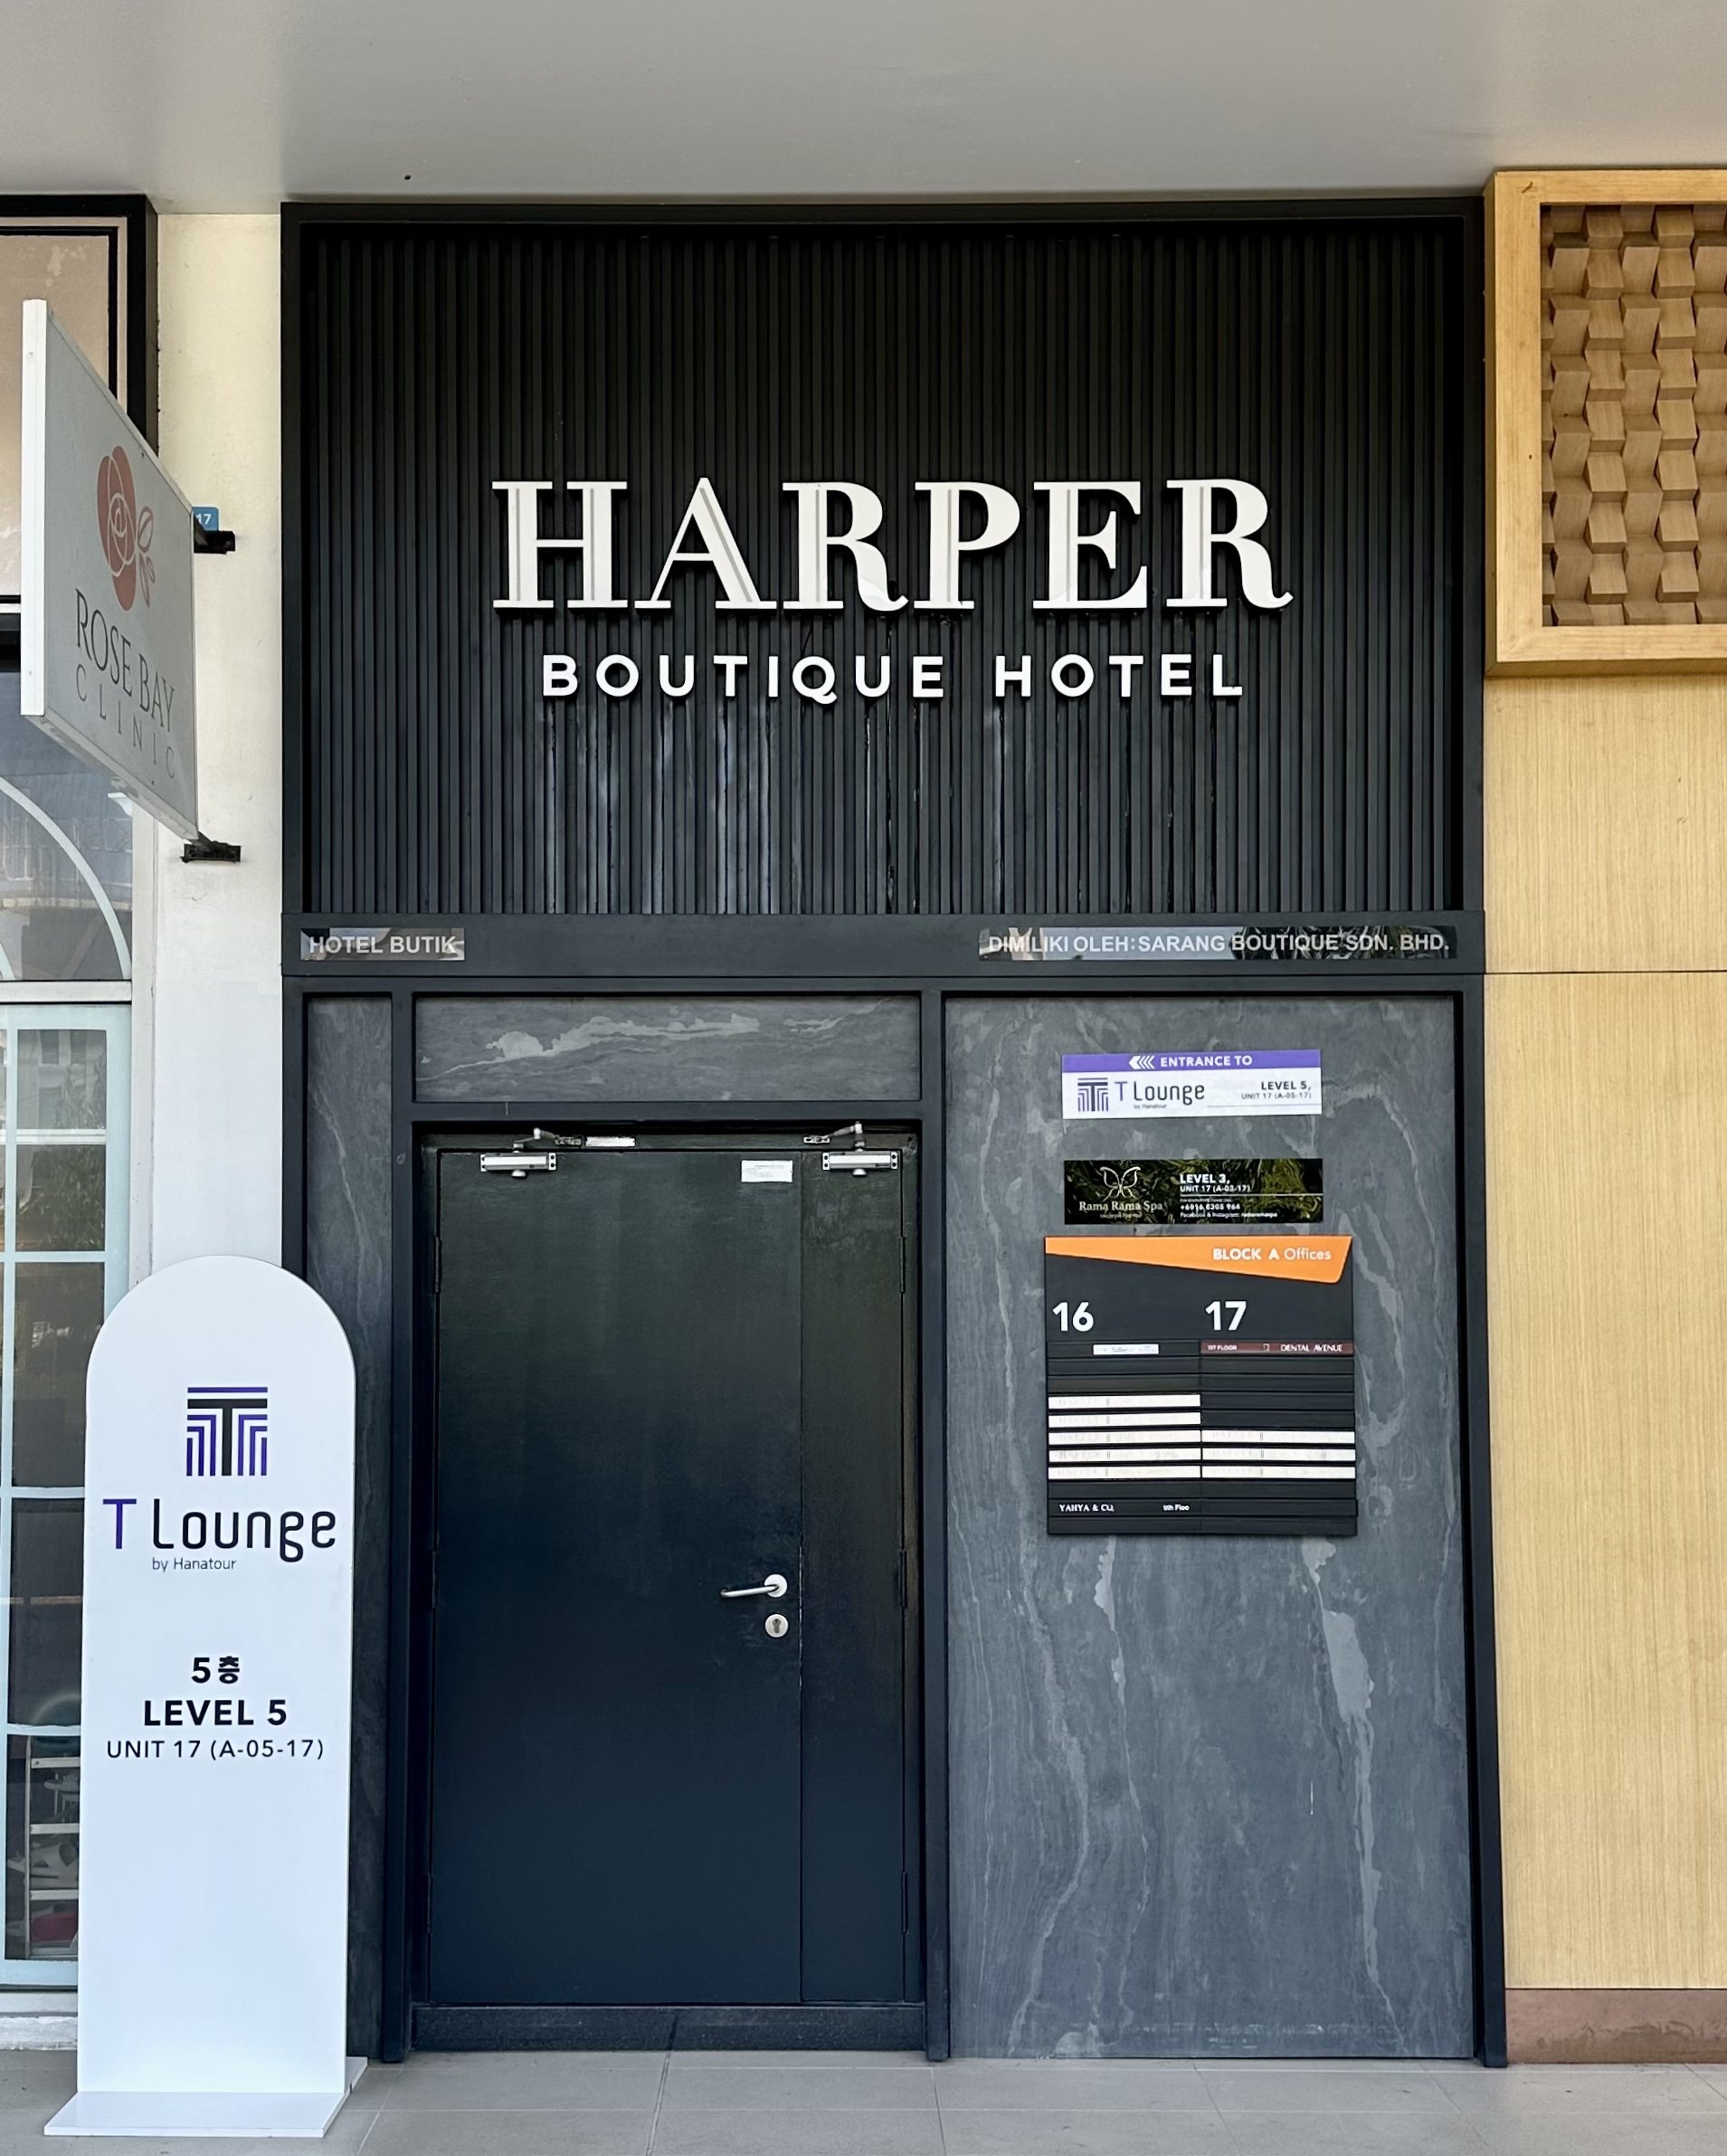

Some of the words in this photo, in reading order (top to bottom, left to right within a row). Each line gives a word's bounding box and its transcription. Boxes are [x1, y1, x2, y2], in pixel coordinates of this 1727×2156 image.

[491, 476, 1295, 613] HARPER
[75, 588, 132, 698] ROSE
[138, 652, 175, 733] BAY
[542, 654, 944, 705] BOUTIQUE
[994, 652, 1244, 698] HOTEL
[75, 662, 176, 780] CLINIC
[309, 936, 384, 954] HOTEL
[390, 936, 457, 954] BUTIK
[989, 936, 1069, 953] DIMILIKI
[1231, 934, 1340, 953] BOUTIQUE
[1345, 934, 1394, 952] SDN.
[1400, 934, 1449, 951] BHD.
[1160, 1056, 1231, 1068] ENTRANCE
[1234, 1055, 1253, 1066] TO
[1115, 1080, 1128, 1101] T
[1134, 1080, 1206, 1106] Lounge
[1260, 1080, 1296, 1091] LEVEL
[1300, 1080, 1312, 1091] 5,
[1180, 1173, 1217, 1184] LEVEL
[1218, 1173, 1231, 1185] 3,
[1180, 1184, 1200, 1192] UNIT
[1201, 1184, 1211, 1192] 17
[1079, 1201, 1109, 1212] Rama
[1143, 1200, 1163, 1213] Spa
[1212, 1248, 1262, 1260] BLOCK
[1267, 1249, 1280, 1260] A
[1284, 1247, 1333, 1260] Offices
[1052, 1301, 1095, 1333] 16
[1205, 1299, 1248, 1332] 17
[1280, 1344, 1310, 1352] DENTAL
[1313, 1344, 1343, 1352] AVENUE
[102, 1498, 137, 1550] T
[152, 1498, 337, 1563] Lounge
[151, 1556, 169, 1573] by
[173, 1556, 238, 1572] Hanatour
[191, 1655, 242, 1685] 5층
[144, 1699, 254, 1727] LEVEL
[267, 1699, 288, 1726] 5
[107, 1740, 166, 1759] UNIT
[173, 1740, 202, 1759] 17
[209, 1738, 325, 1761] (A-05-17)
